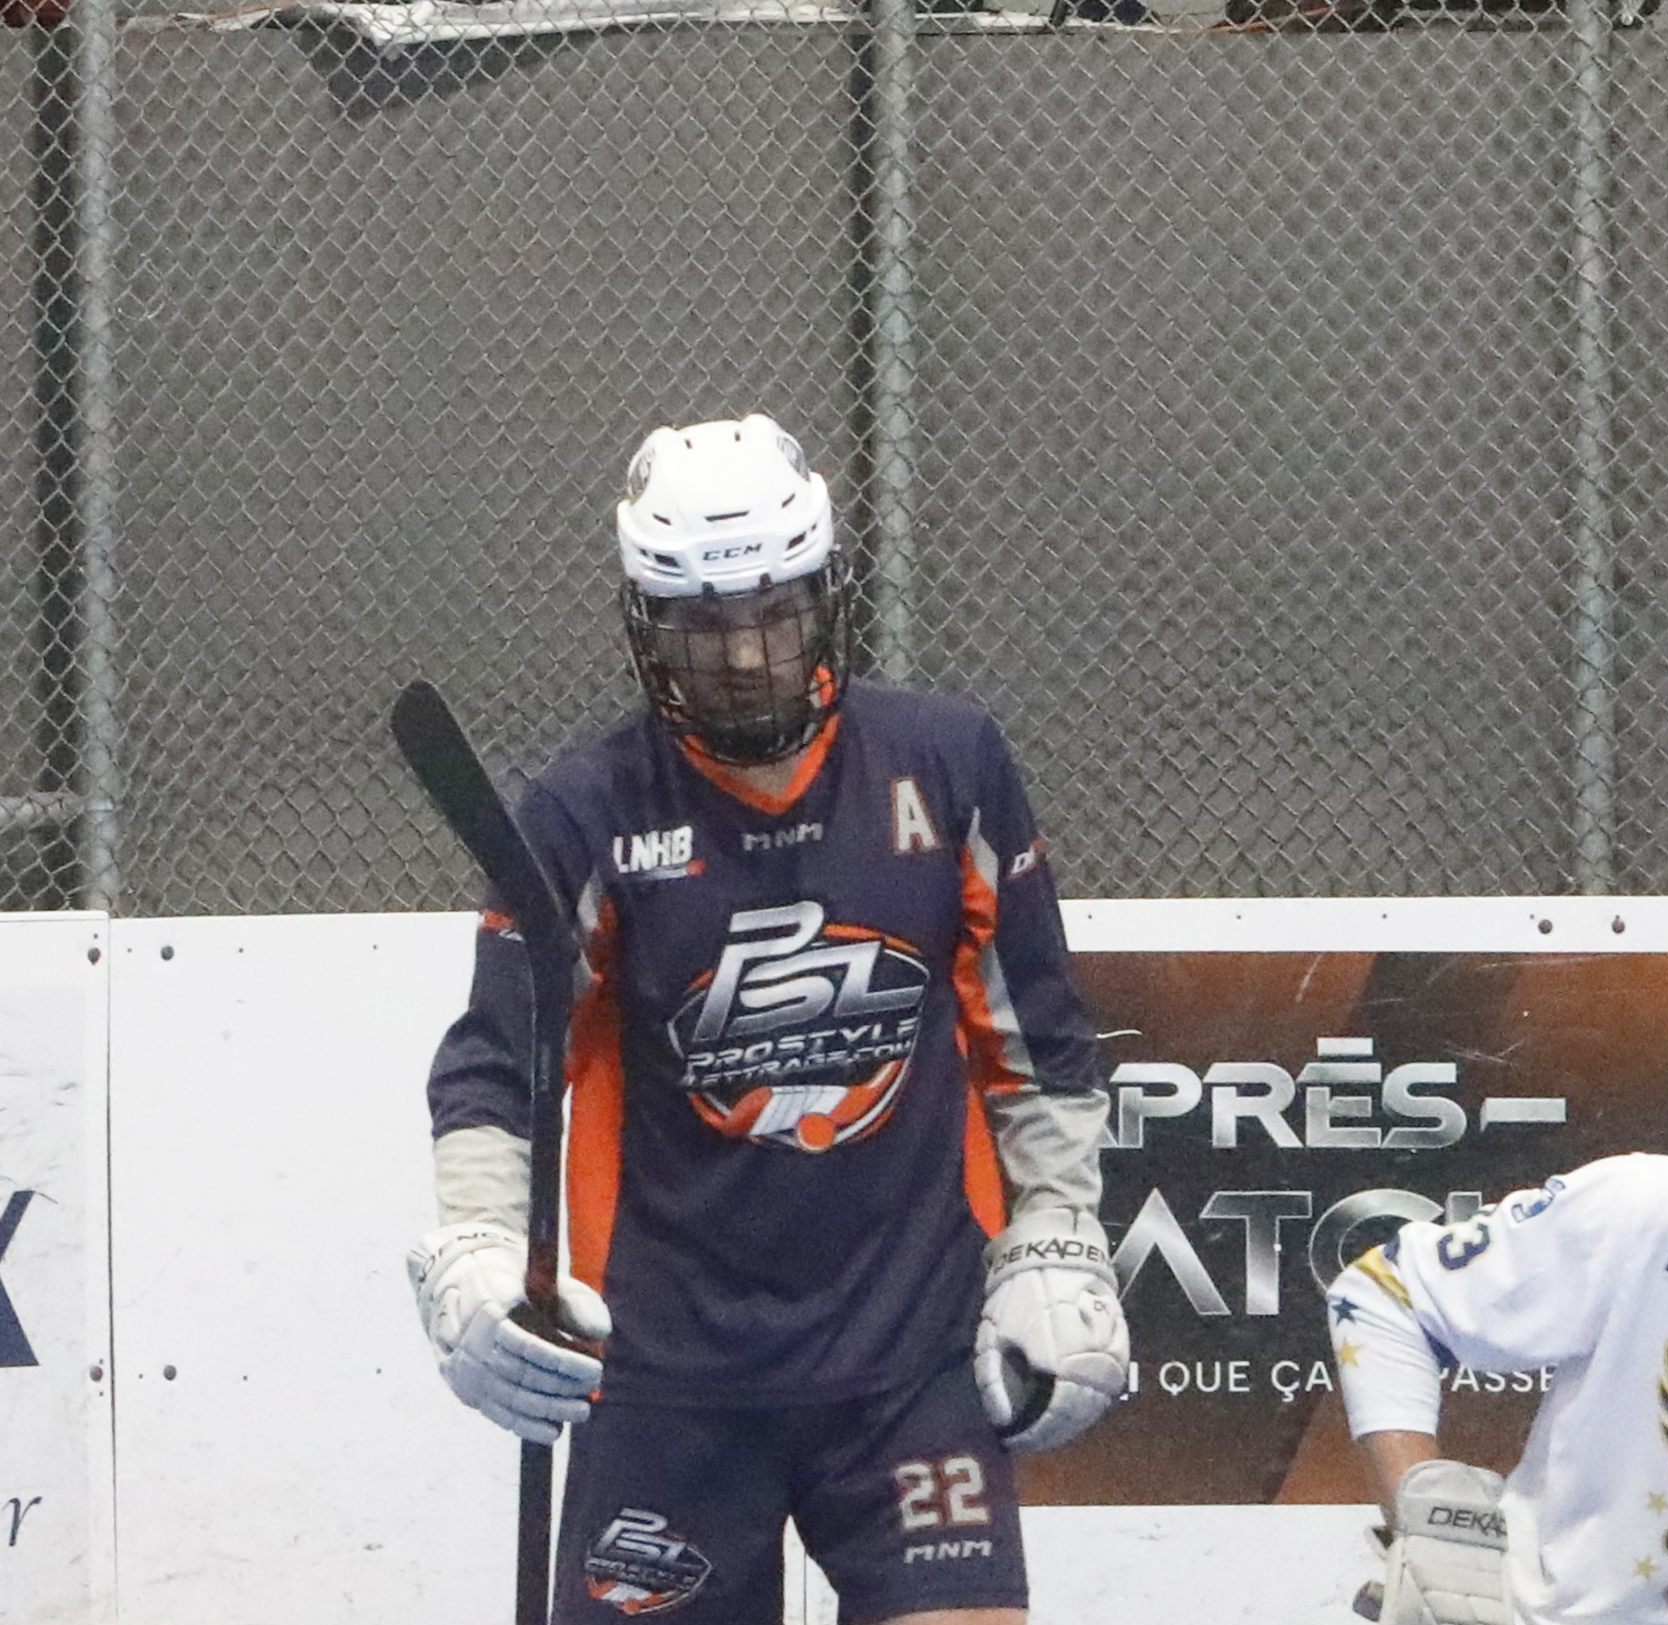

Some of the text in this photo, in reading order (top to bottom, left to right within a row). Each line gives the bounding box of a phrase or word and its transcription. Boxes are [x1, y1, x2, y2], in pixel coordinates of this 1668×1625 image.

[702, 543, 763, 562] CCM
[742, 822, 824, 851] MNM
[890, 776, 943, 855] A
[612, 825, 694, 874] LNHB
[692, 900, 926, 1043] PSL
[1158, 1360, 1251, 1395] QUE
[1270, 1360, 1335, 1402] ÇA
[894, 1456, 990, 1530] 22
[903, 1540, 993, 1564] MNM
